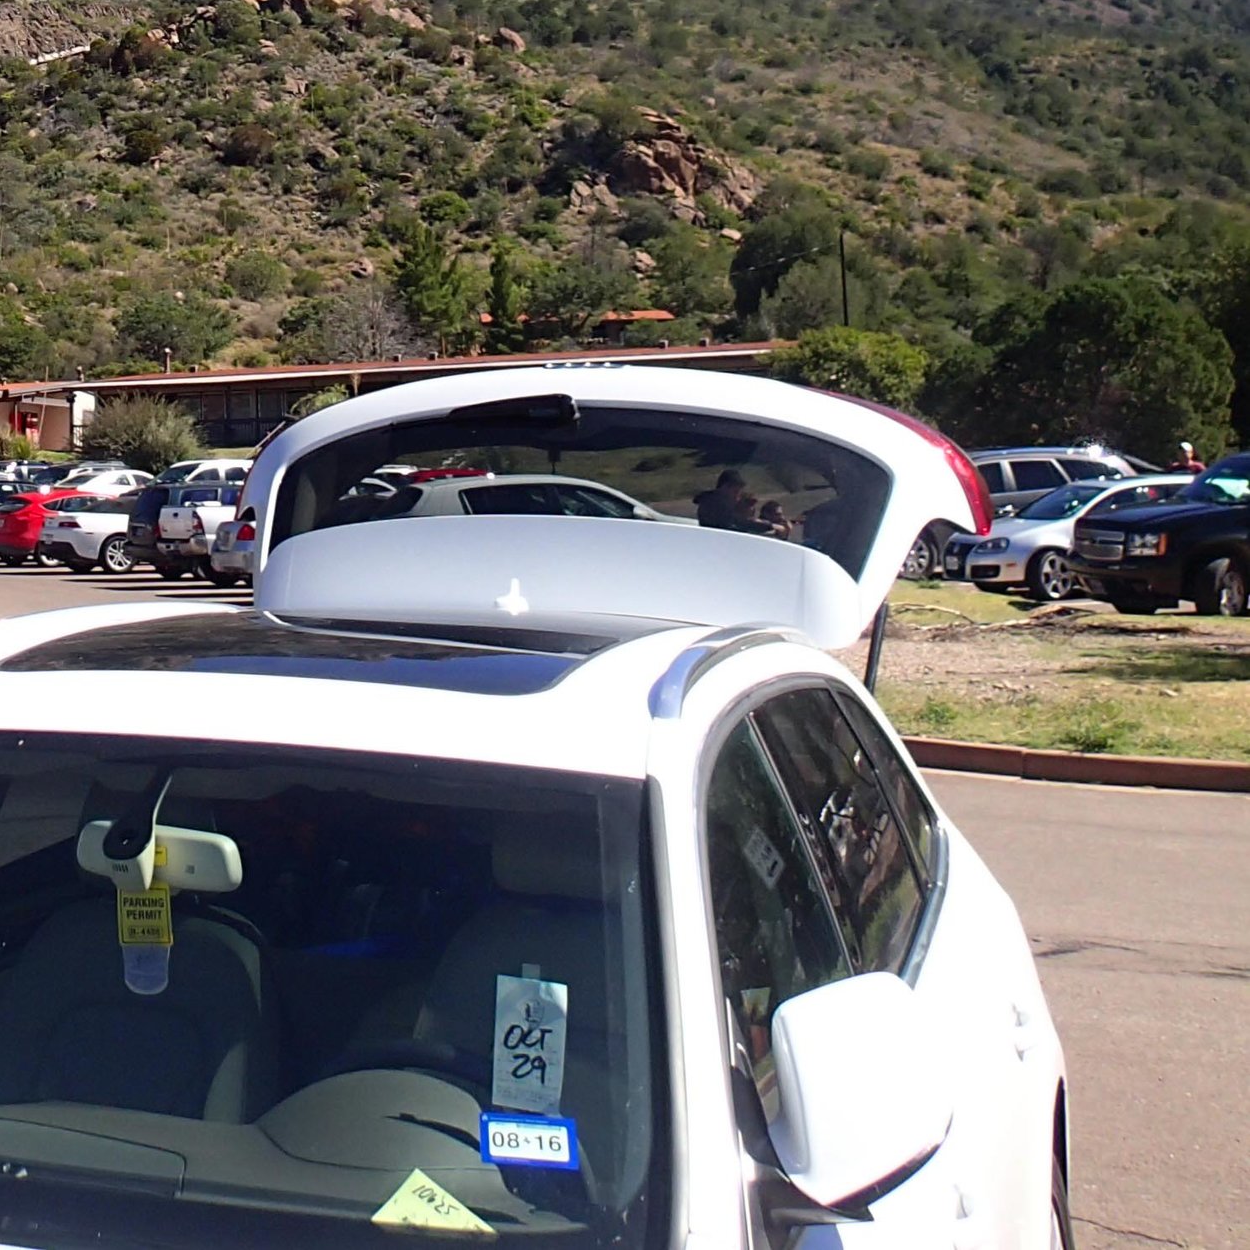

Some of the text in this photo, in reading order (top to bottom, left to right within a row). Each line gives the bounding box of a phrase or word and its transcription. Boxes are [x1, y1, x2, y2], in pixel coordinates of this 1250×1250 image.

[123, 897, 165, 908] PARKING
[126, 909, 162, 920] PERMIT
[503, 1023, 554, 1051] OCT
[511, 1053, 547, 1086] 29
